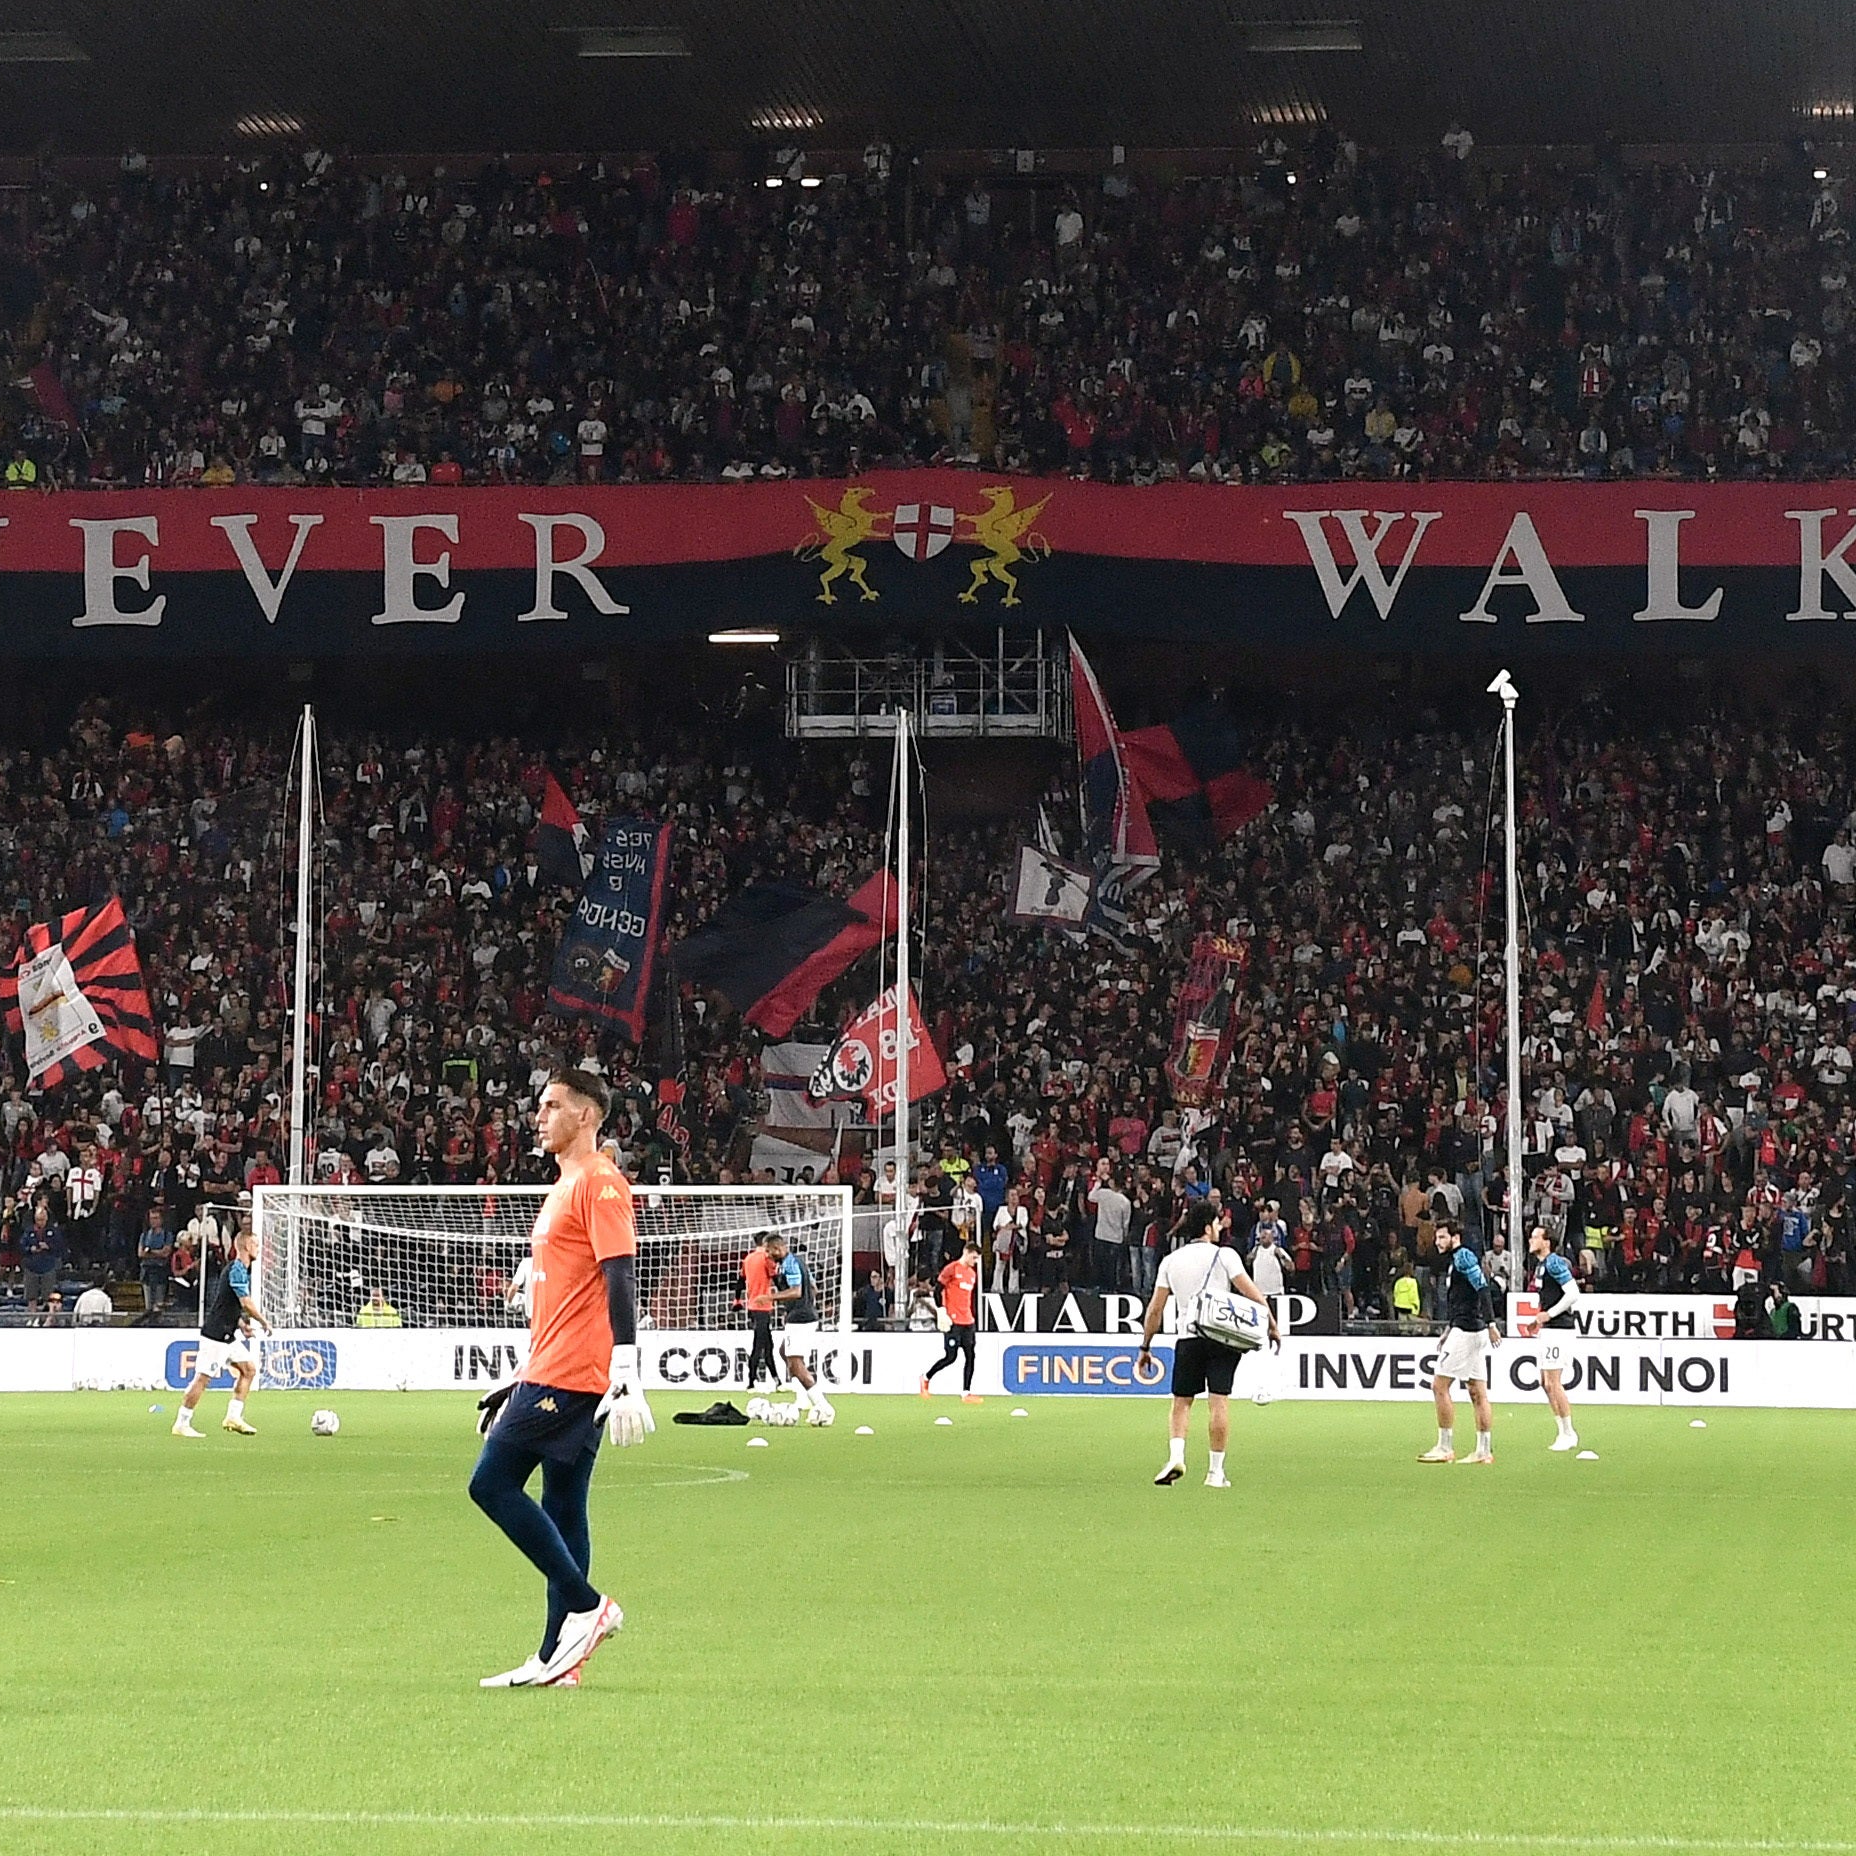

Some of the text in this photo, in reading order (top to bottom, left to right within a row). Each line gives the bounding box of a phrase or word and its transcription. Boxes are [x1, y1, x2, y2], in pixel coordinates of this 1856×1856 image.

[982, 1292, 1318, 1334] MARP
[1017, 1354, 1166, 1386] FINECO
[1545, 1347, 1560, 1360] 20
[1299, 1353, 1491, 1390] INVESI
[1639, 1357, 1728, 1393] NOI
